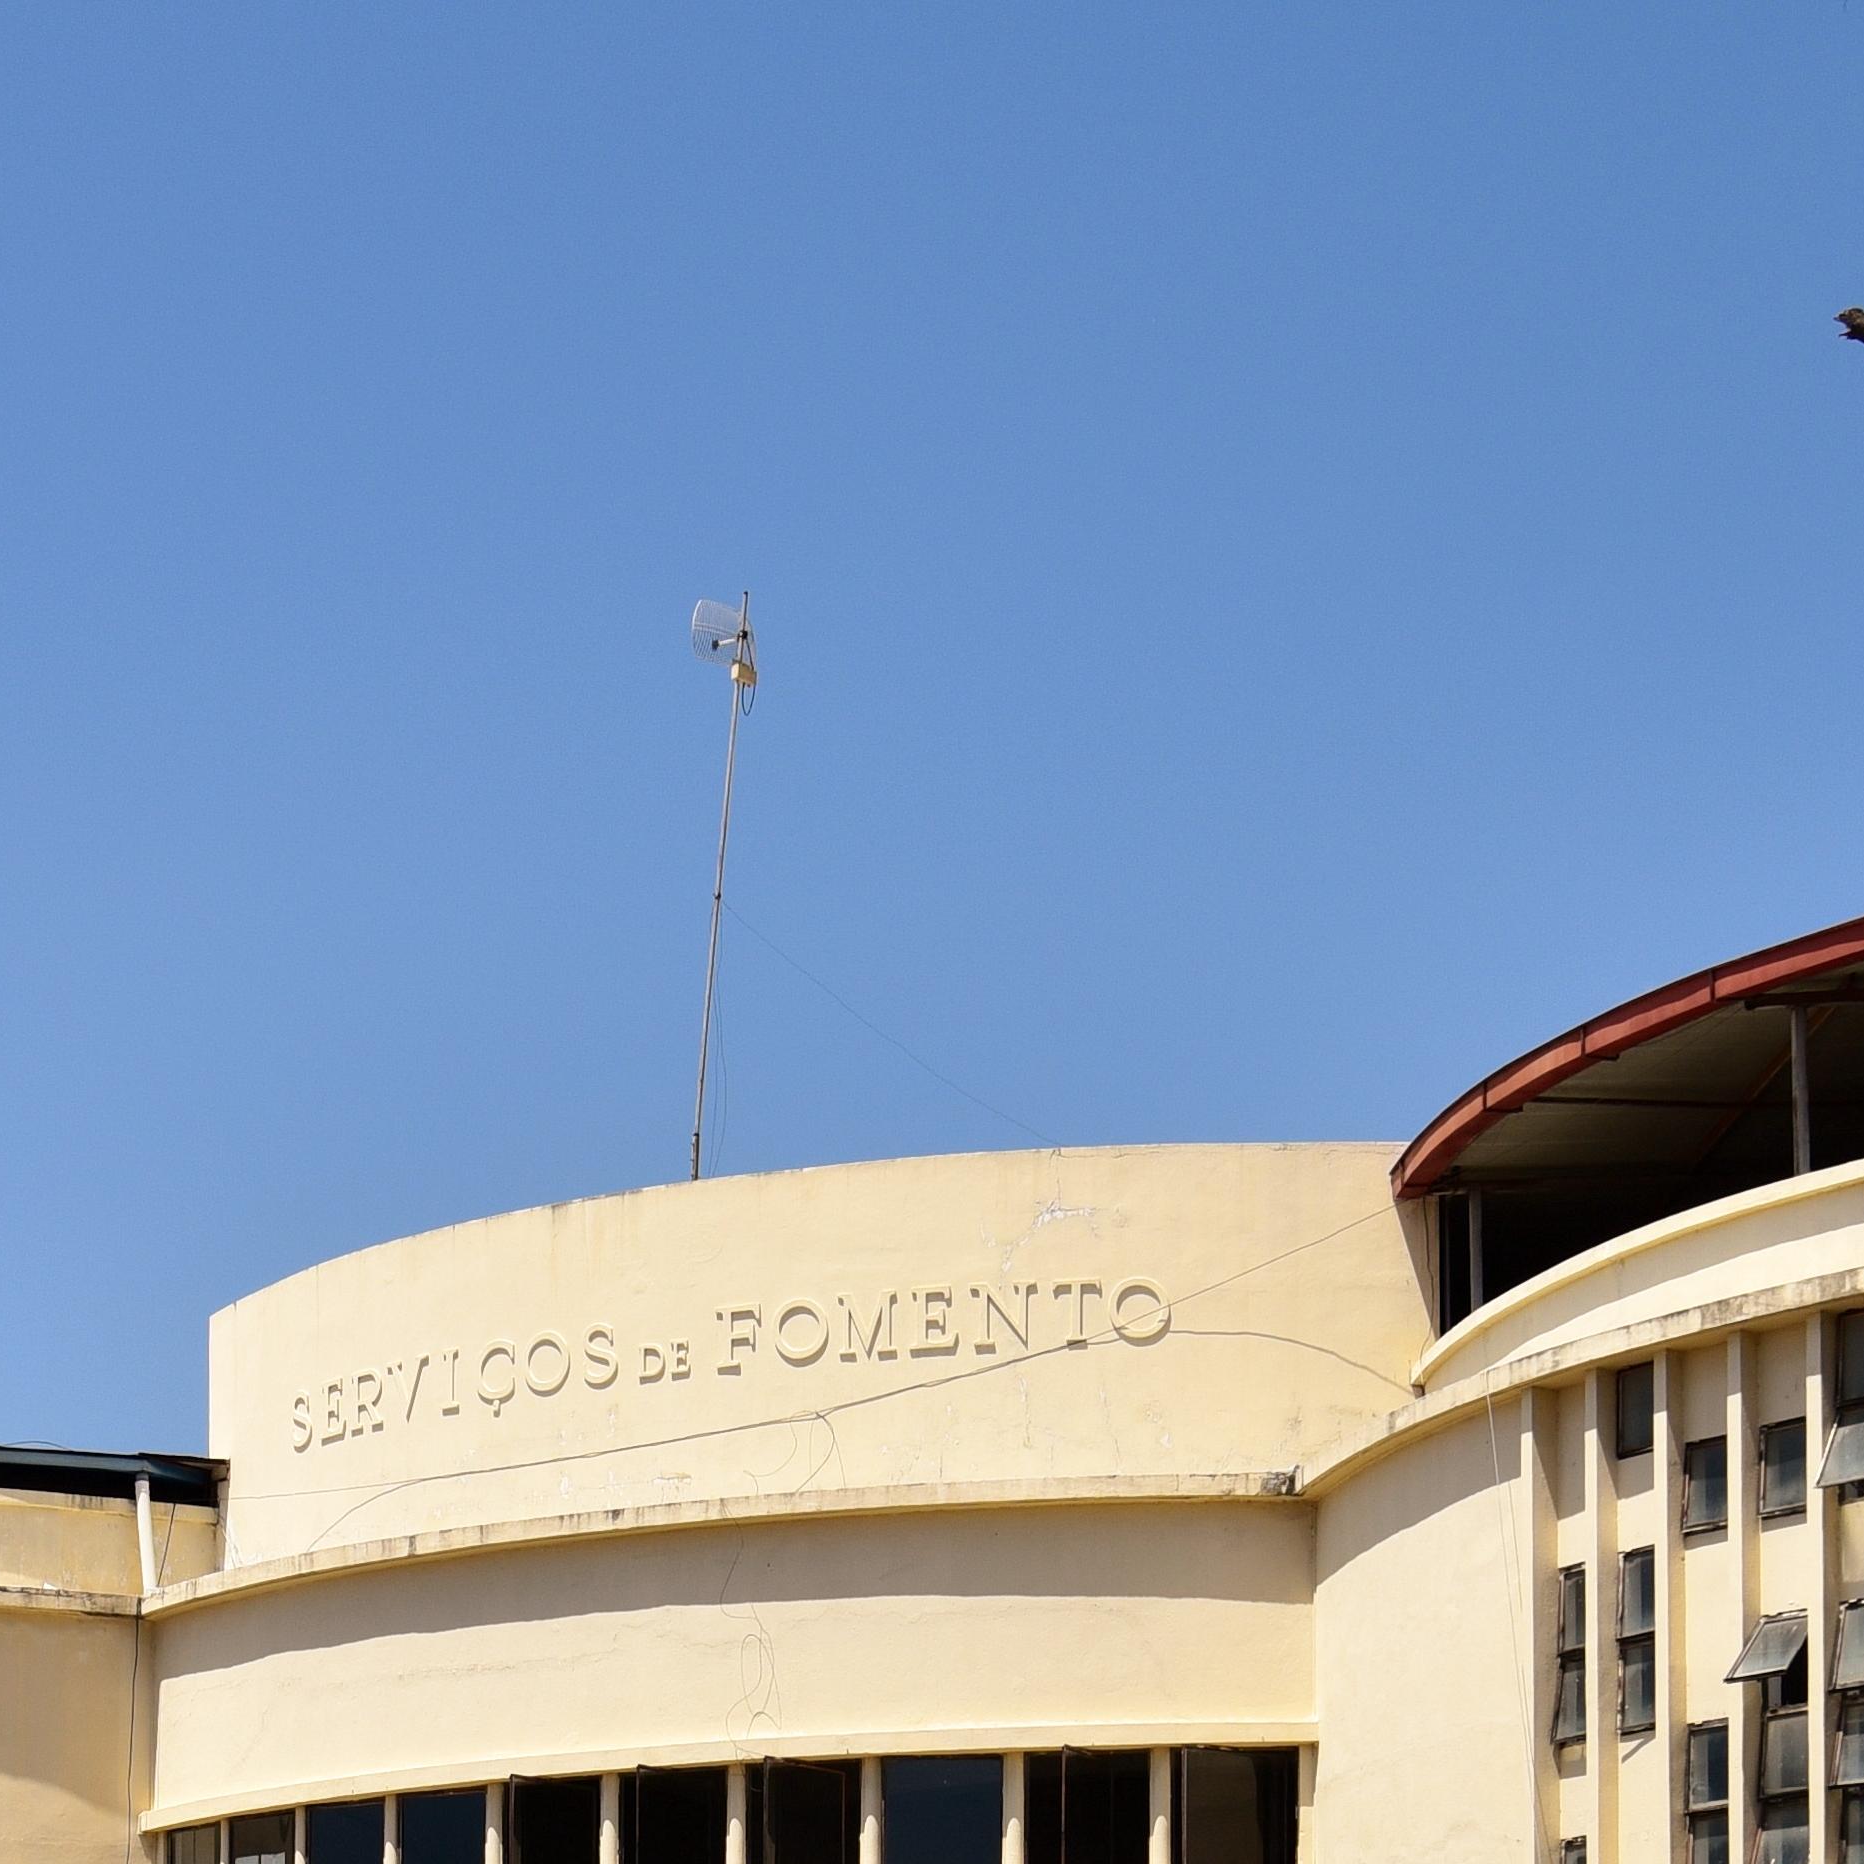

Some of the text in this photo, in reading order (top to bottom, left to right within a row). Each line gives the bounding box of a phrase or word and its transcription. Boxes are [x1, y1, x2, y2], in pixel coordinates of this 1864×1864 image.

[291, 1276, 1173, 1454] SERVIÇOS DE FOMENTO
